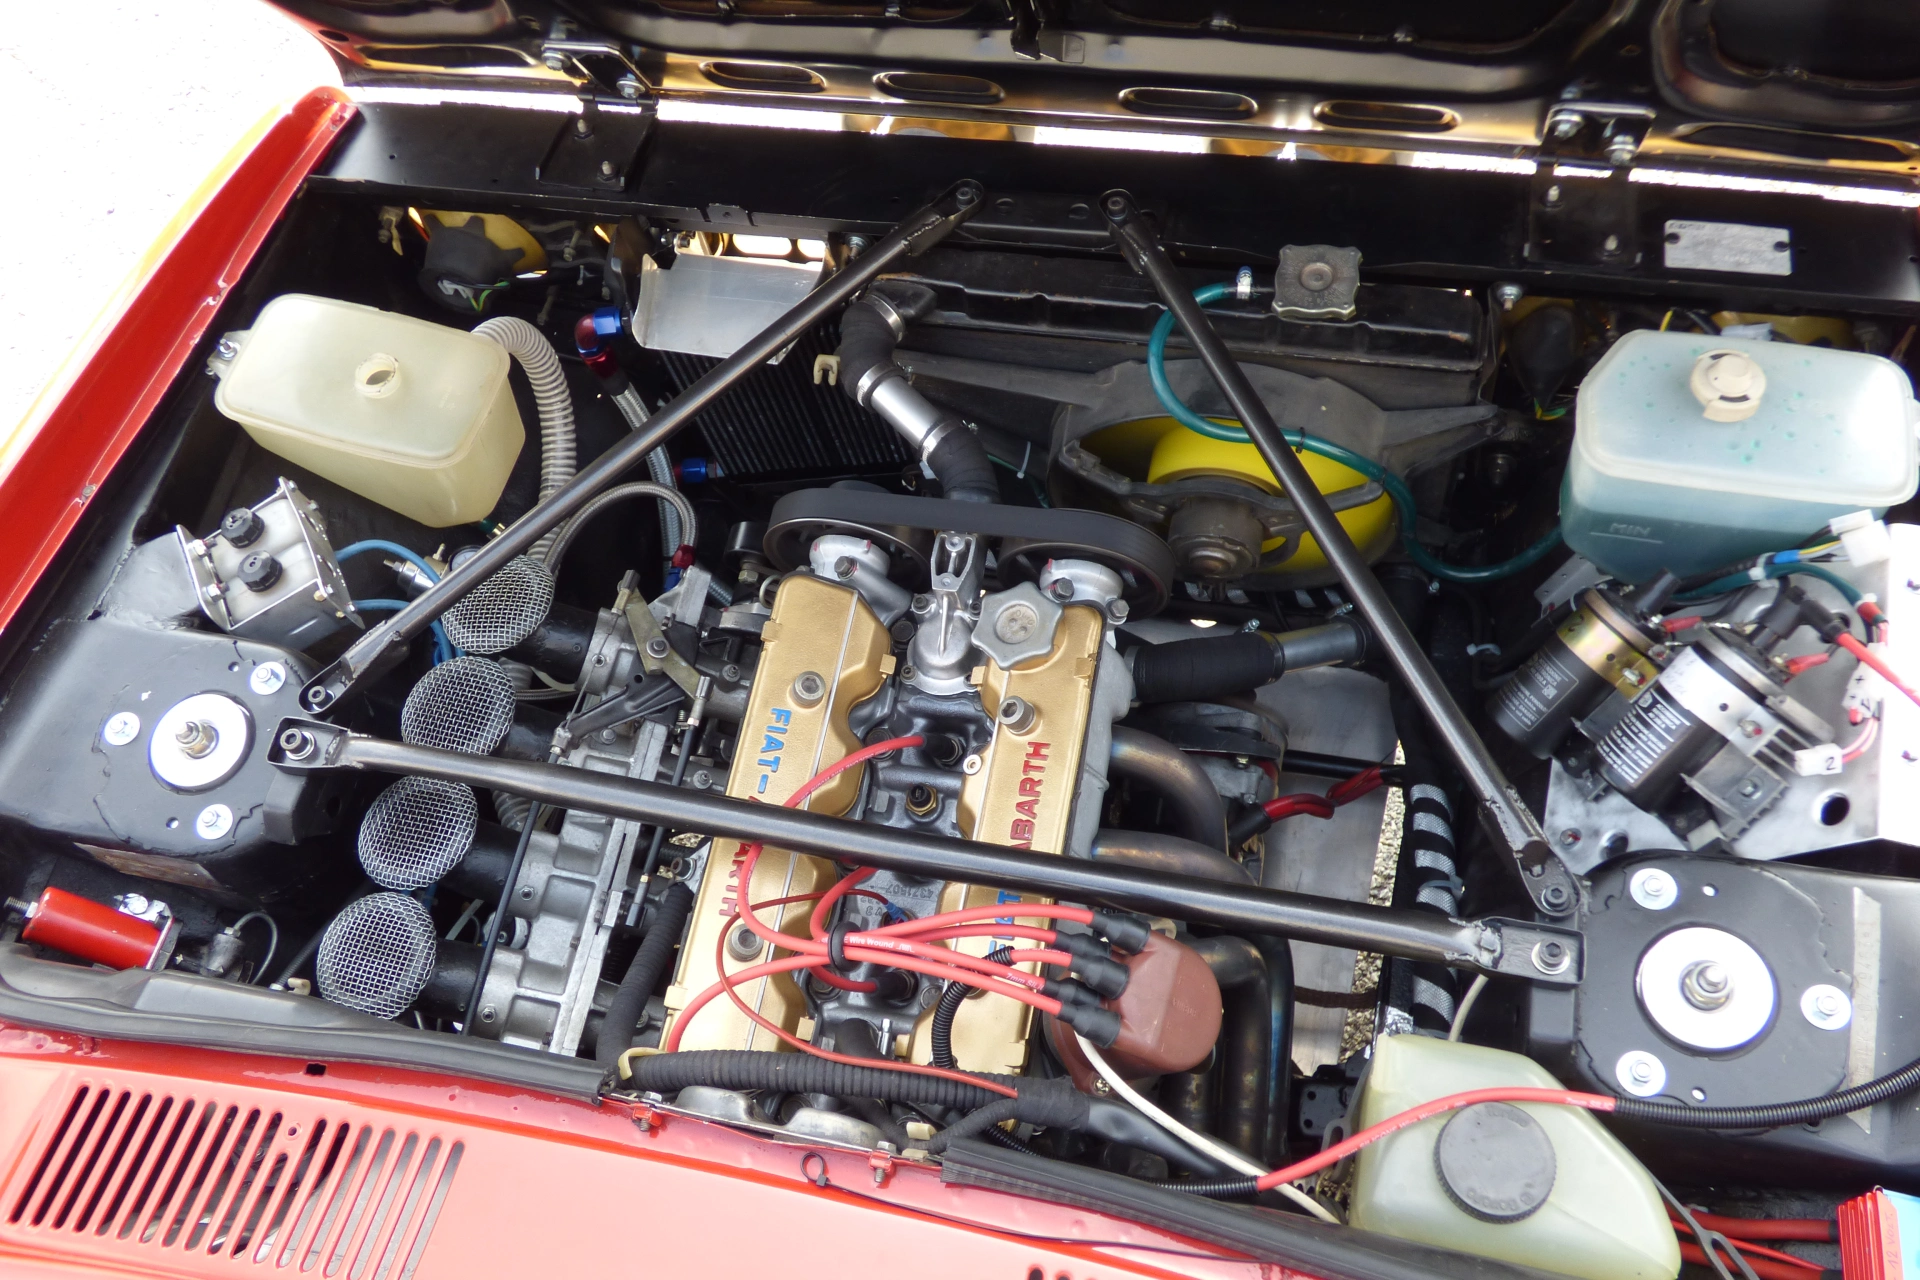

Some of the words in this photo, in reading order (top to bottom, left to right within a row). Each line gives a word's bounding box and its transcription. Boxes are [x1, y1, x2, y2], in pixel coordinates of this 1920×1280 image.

[1608, 522, 1651, 537] MIN
[1825, 756, 1837, 771] 2
[849, 936, 866, 945] Wire
[866, 938, 894, 949] Wound
[1006, 972, 1025, 984] 7mm
